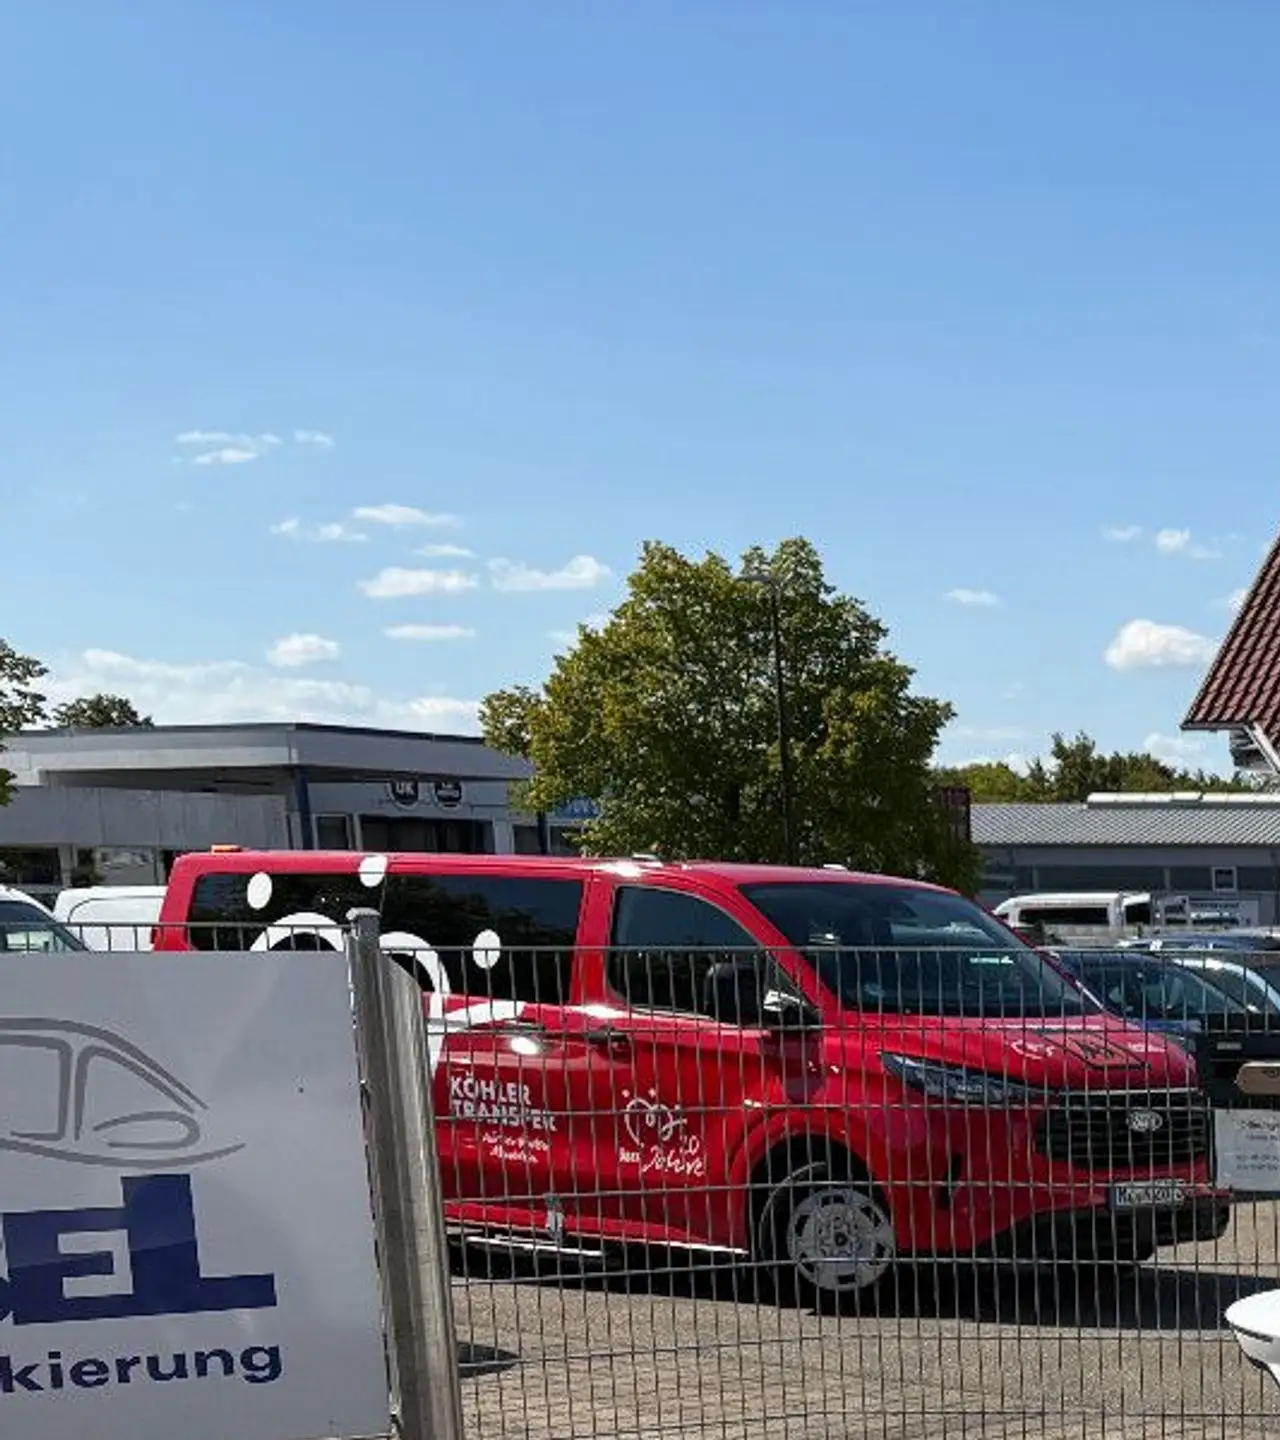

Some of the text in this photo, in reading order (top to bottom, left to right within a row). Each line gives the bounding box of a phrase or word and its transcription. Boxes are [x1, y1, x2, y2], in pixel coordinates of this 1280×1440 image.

[450, 1070, 532, 1105] KÖHLER
[0, 1173, 277, 1325] EL
[0, 1345, 283, 1393] kierung
